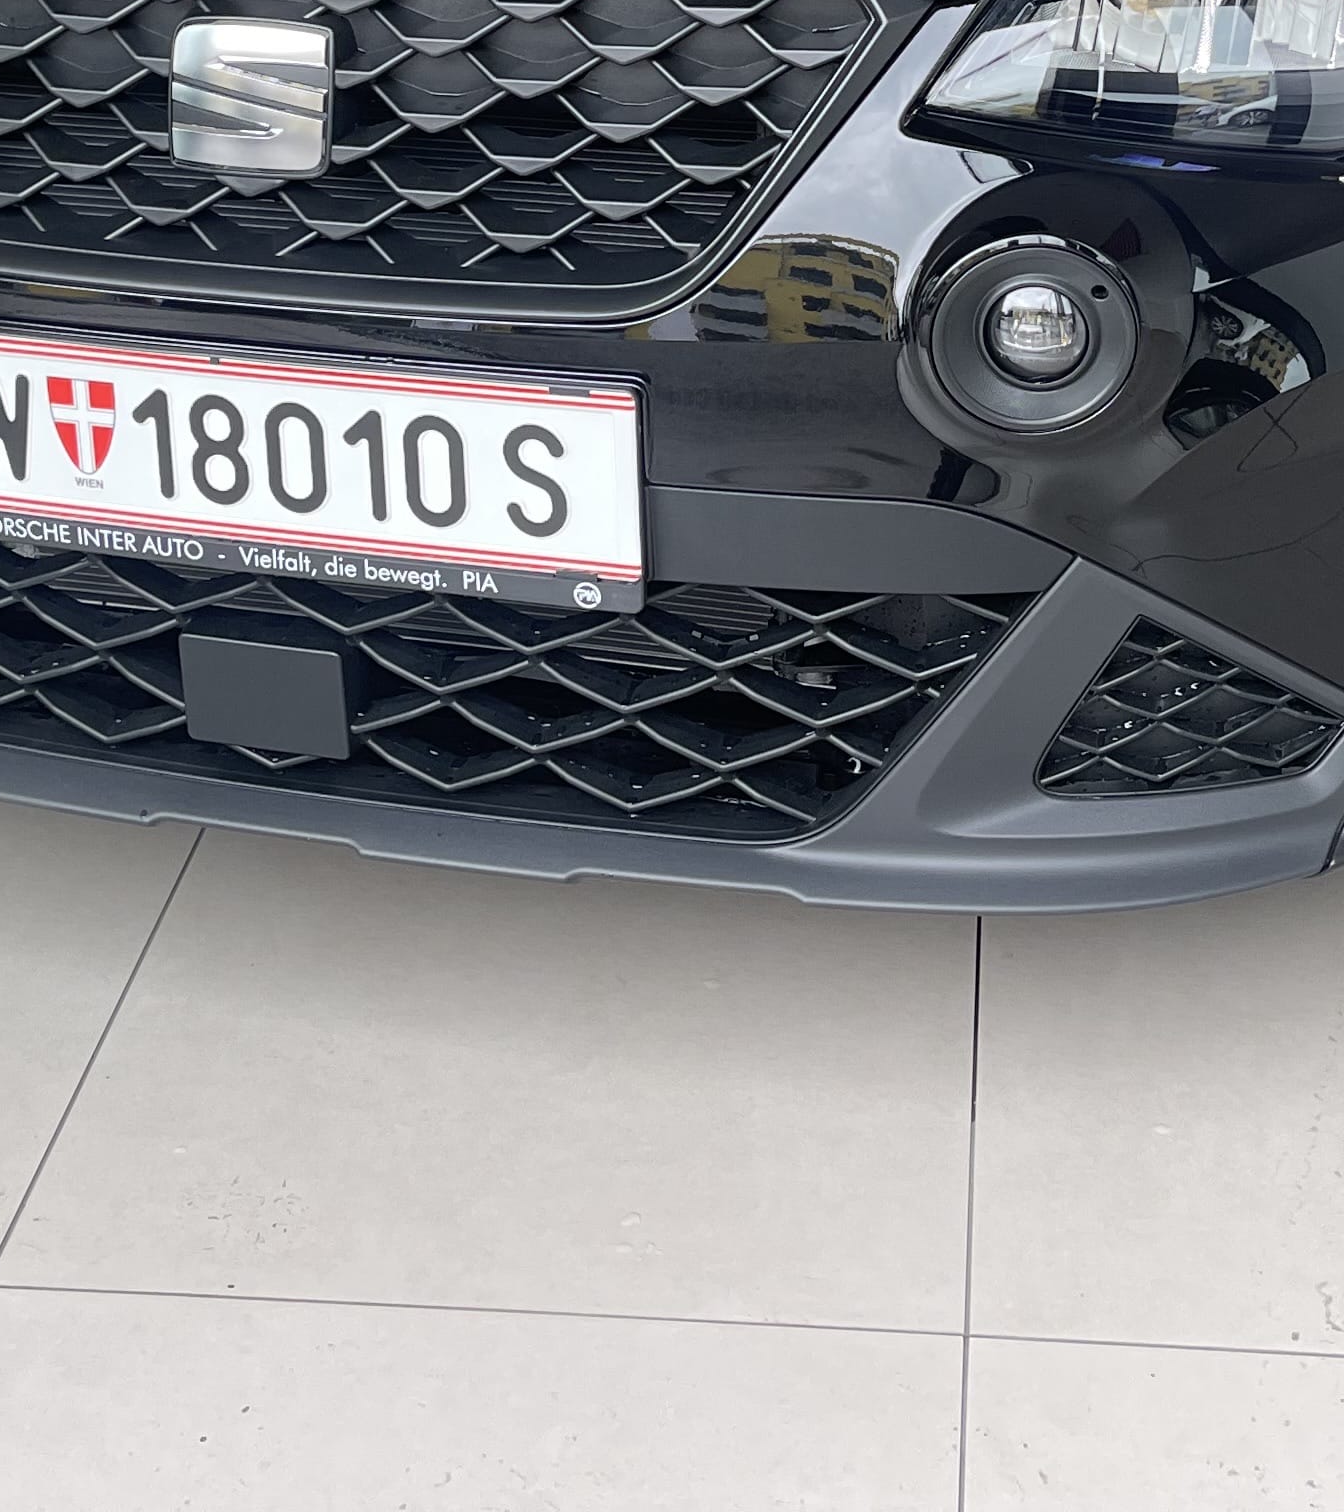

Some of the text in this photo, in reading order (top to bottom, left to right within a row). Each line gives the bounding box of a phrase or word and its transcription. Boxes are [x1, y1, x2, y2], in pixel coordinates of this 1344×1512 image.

[74, 476, 105, 490] WIEN
[132, 388, 467, 528] 18010
[502, 423, 568, 538] S
[77, 526, 138, 553] INTER
[142, 536, 204, 561] AUTO
[238, 546, 319, 578] Vielfalt,
[324, 556, 357, 578] die
[364, 559, 448, 591] bewegt.
[462, 571, 499, 594] PIA
